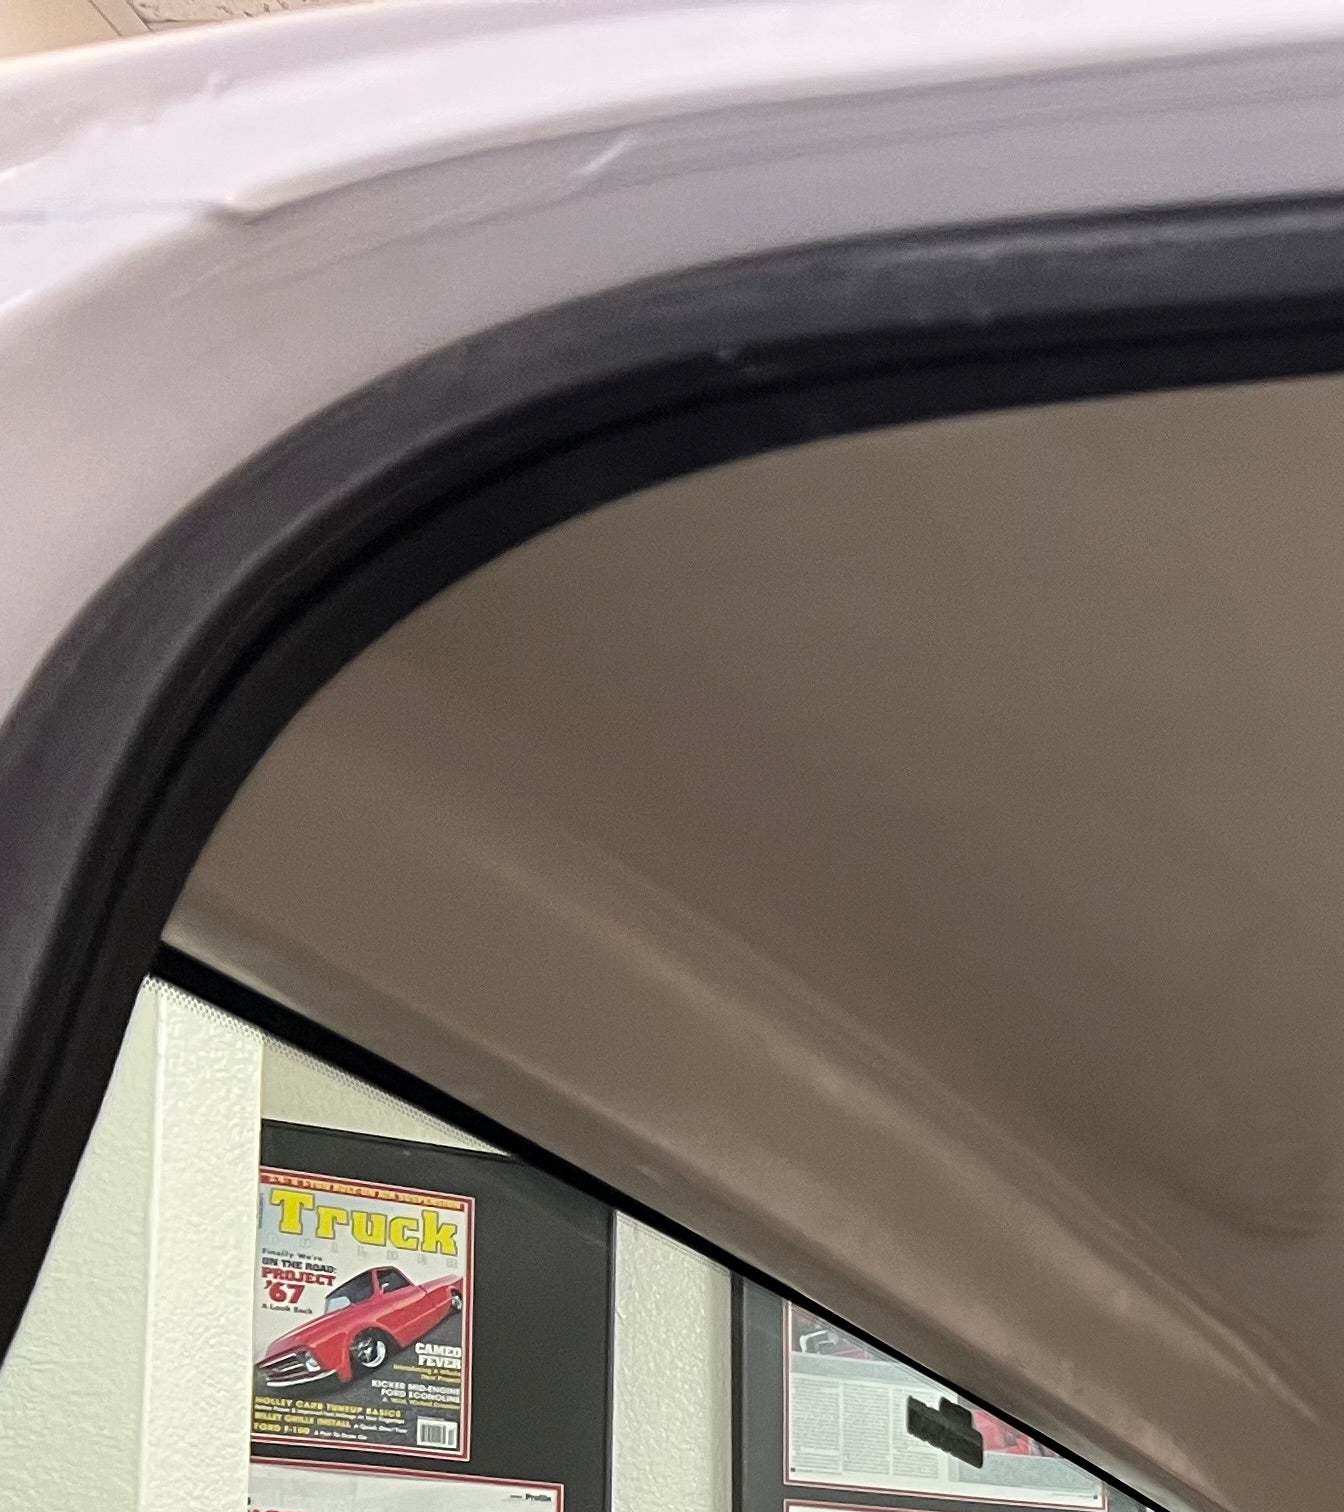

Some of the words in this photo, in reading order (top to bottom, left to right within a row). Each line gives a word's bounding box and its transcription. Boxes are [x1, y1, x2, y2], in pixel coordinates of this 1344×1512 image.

[270, 1188, 459, 1256] Truck
[262, 1257, 279, 1266] ON
[281, 1259, 303, 1270] THE
[261, 1266, 337, 1287] PROJECT
[264, 1279, 306, 1304] '67
[414, 1342, 462, 1358] CAMEO
[418, 1354, 462, 1370] FEVER
[381, 1388, 407, 1398] FORD
[366, 1407, 402, 1418] BASICS
[253, 1422, 282, 1433] FORD
